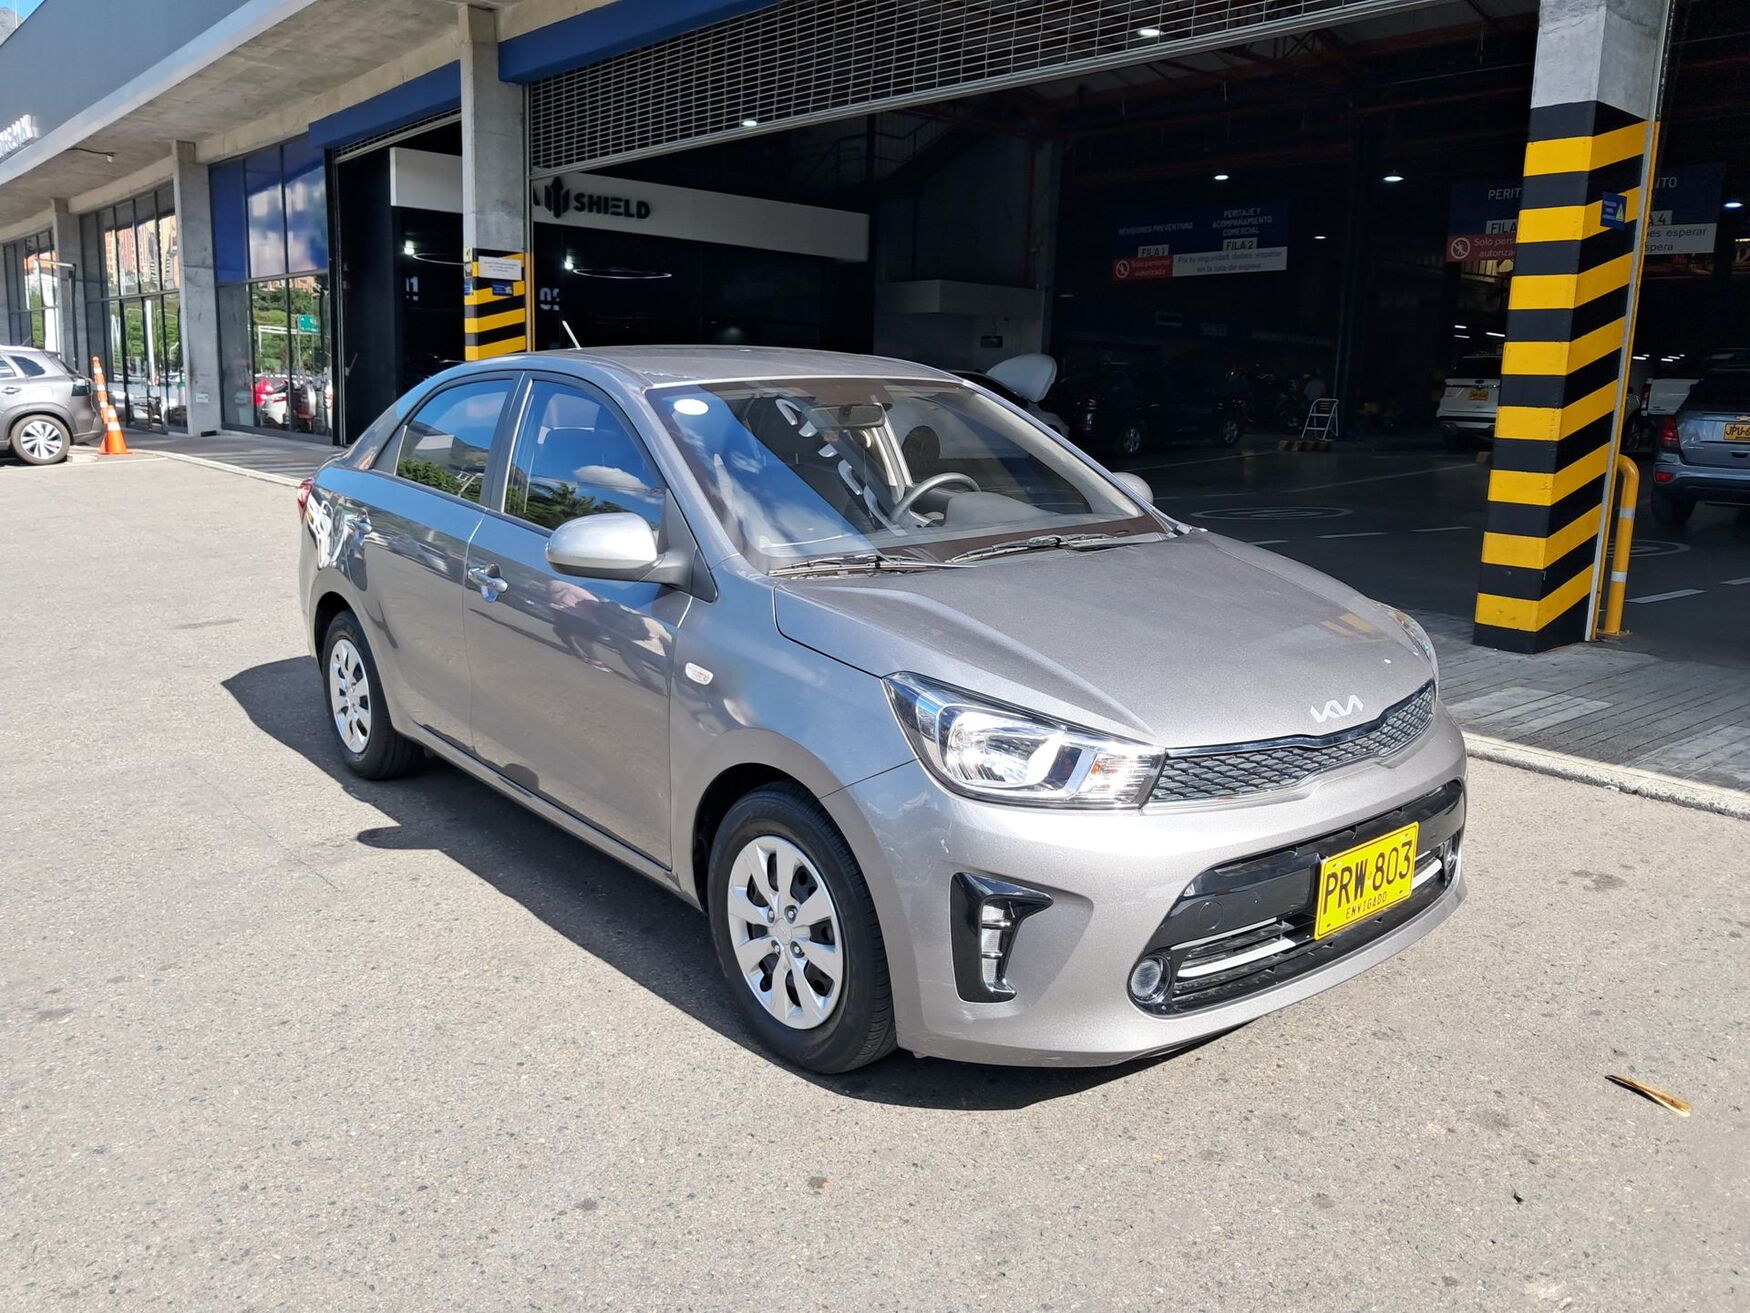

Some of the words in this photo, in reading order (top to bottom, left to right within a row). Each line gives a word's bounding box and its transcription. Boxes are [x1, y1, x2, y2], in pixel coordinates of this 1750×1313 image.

[573, 192, 651, 219] SHIELD
[1658, 212, 1666, 224] 4
[1491, 221, 1516, 233] FILA
[1666, 228, 1708, 239] esperar
[1226, 241, 1246, 250] FILA
[1247, 240, 1254, 249] 2
[1473, 237, 1494, 247] Solo
[1142, 247, 1160, 256] FILA
[1310, 694, 1363, 723] KIA
[1323, 858, 1369, 915] PRW
[1372, 839, 1413, 892] 803
[1344, 891, 1388, 920] ENVIGADO
